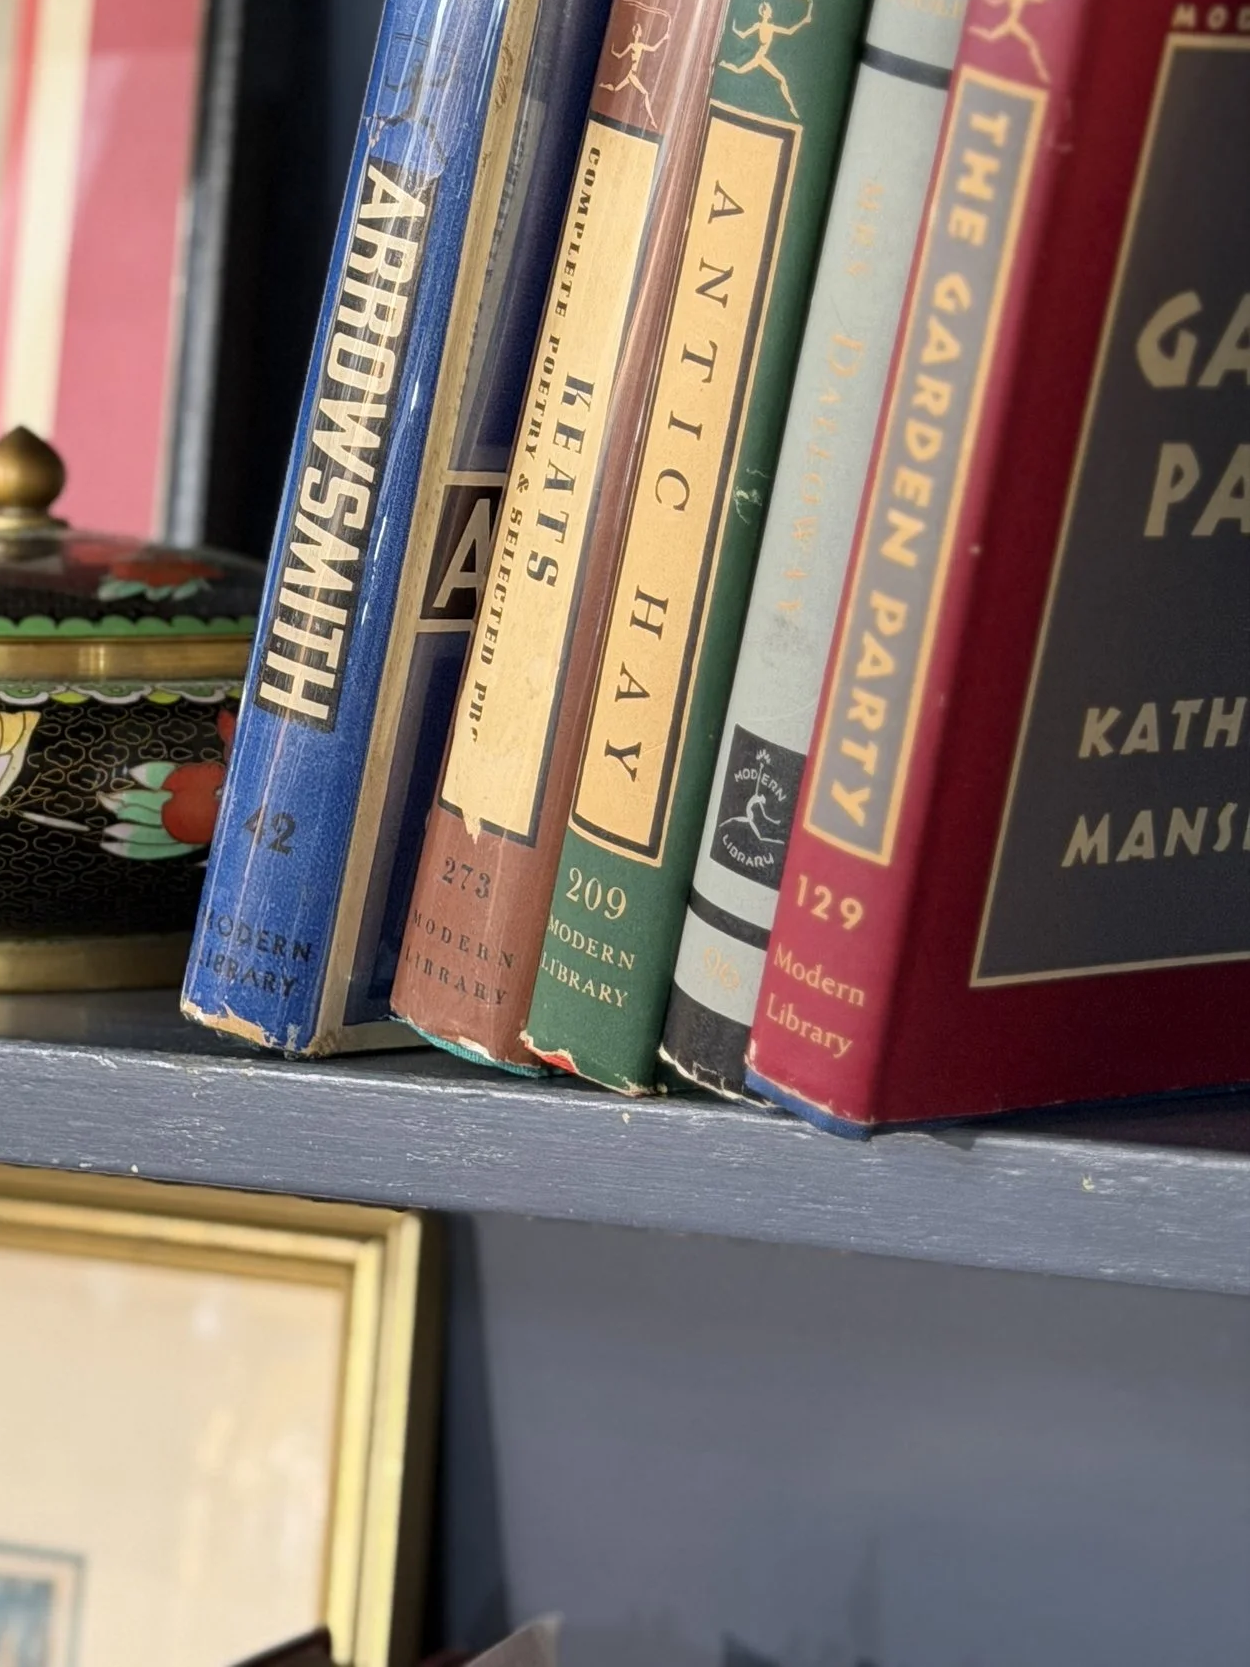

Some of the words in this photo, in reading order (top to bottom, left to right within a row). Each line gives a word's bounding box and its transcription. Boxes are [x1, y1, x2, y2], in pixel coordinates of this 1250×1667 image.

[947, 110, 1010, 247] THE
[555, 145, 601, 318] COMPLETE
[654, 178, 745, 513] ANTIC
[524, 333, 561, 460] POETRY
[878, 272, 973, 569] GARDEN
[258, 164, 427, 721] ARROWSMITH
[516, 472, 530, 494] &
[525, 371, 596, 588] KEATS
[1143, 441, 1250, 537] PA
[479, 506, 523, 666] SELECTED
[603, 584, 670, 783] HAY
[830, 589, 909, 827] PARTY
[1078, 696, 1249, 760] KATH
[734, 768, 787, 803] MODERN
[243, 804, 297, 856] 42
[722, 834, 775, 868] LIBRARY
[441, 855, 491, 900] 273
[565, 866, 627, 920] 209
[795, 874, 865, 931] 129
[411, 908, 515, 970] MODERN
[548, 913, 637, 971] MODERN
[404, 944, 509, 1007] LIBRARY
[540, 951, 629, 1009] LIBRARY
[772, 942, 866, 1007] Modern
[764, 993, 854, 1059] Library
